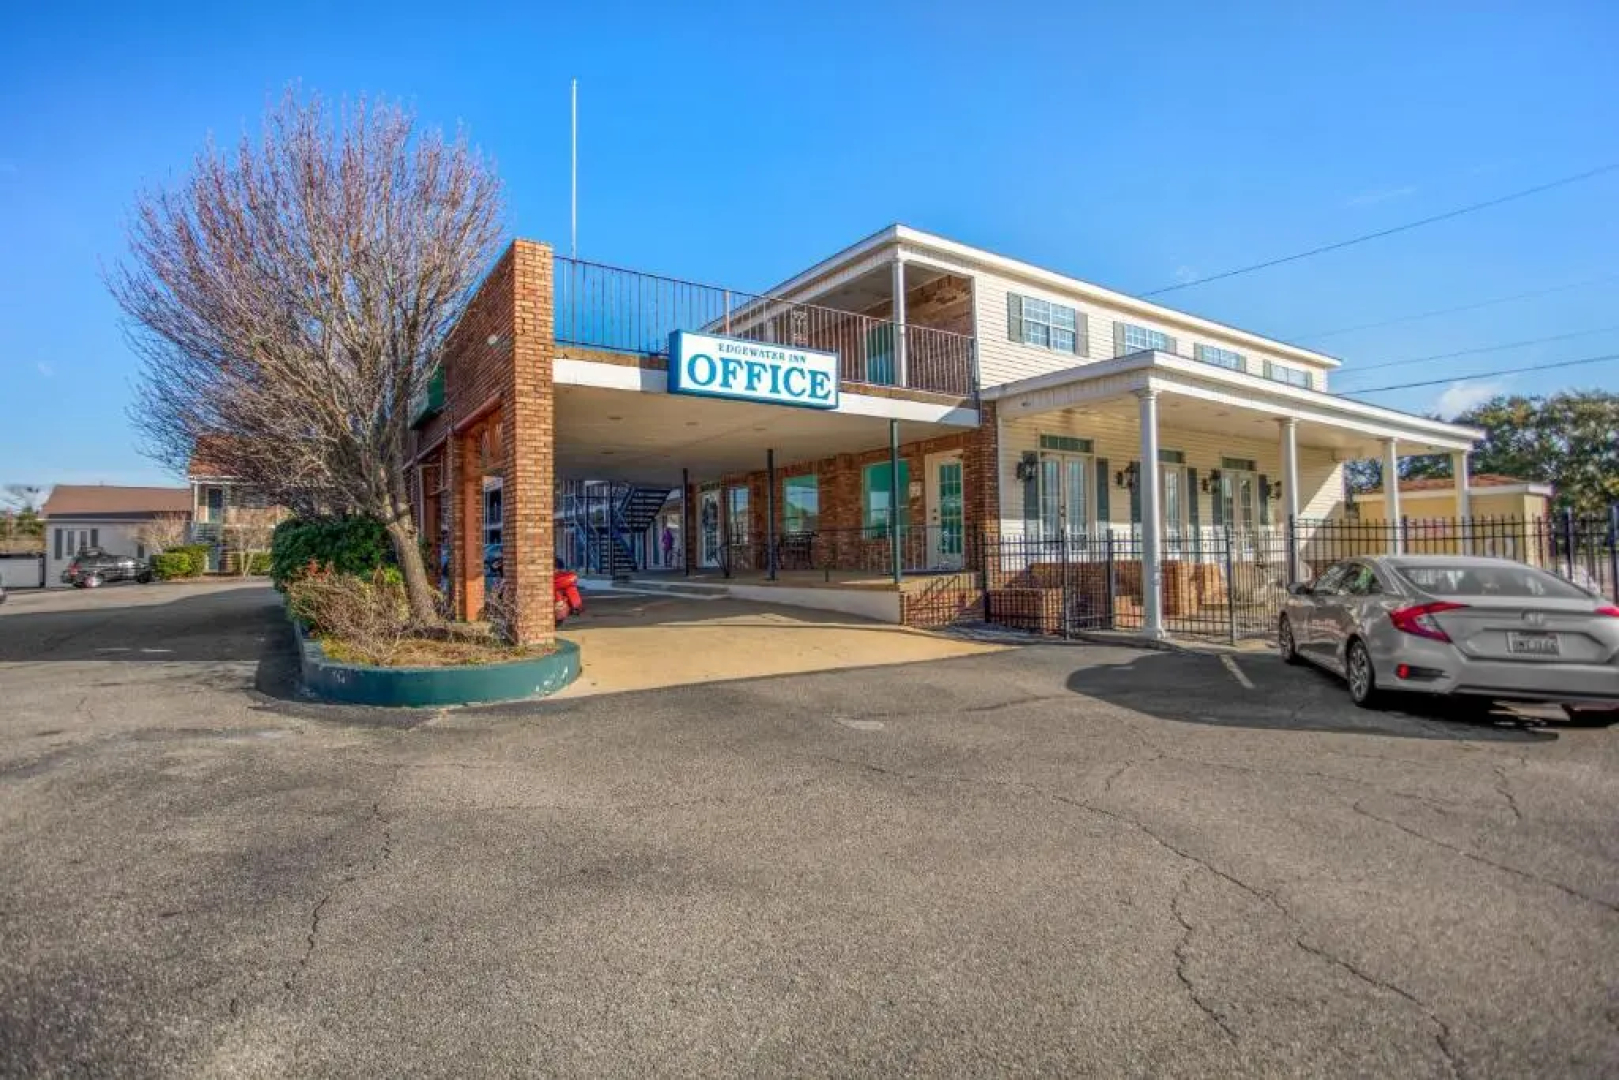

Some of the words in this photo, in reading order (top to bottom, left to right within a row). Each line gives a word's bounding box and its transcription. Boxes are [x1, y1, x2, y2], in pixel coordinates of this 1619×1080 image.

[719, 343, 785, 361] EDGEWATER
[789, 354, 806, 363] INN
[687, 354, 831, 400] OFFICE
